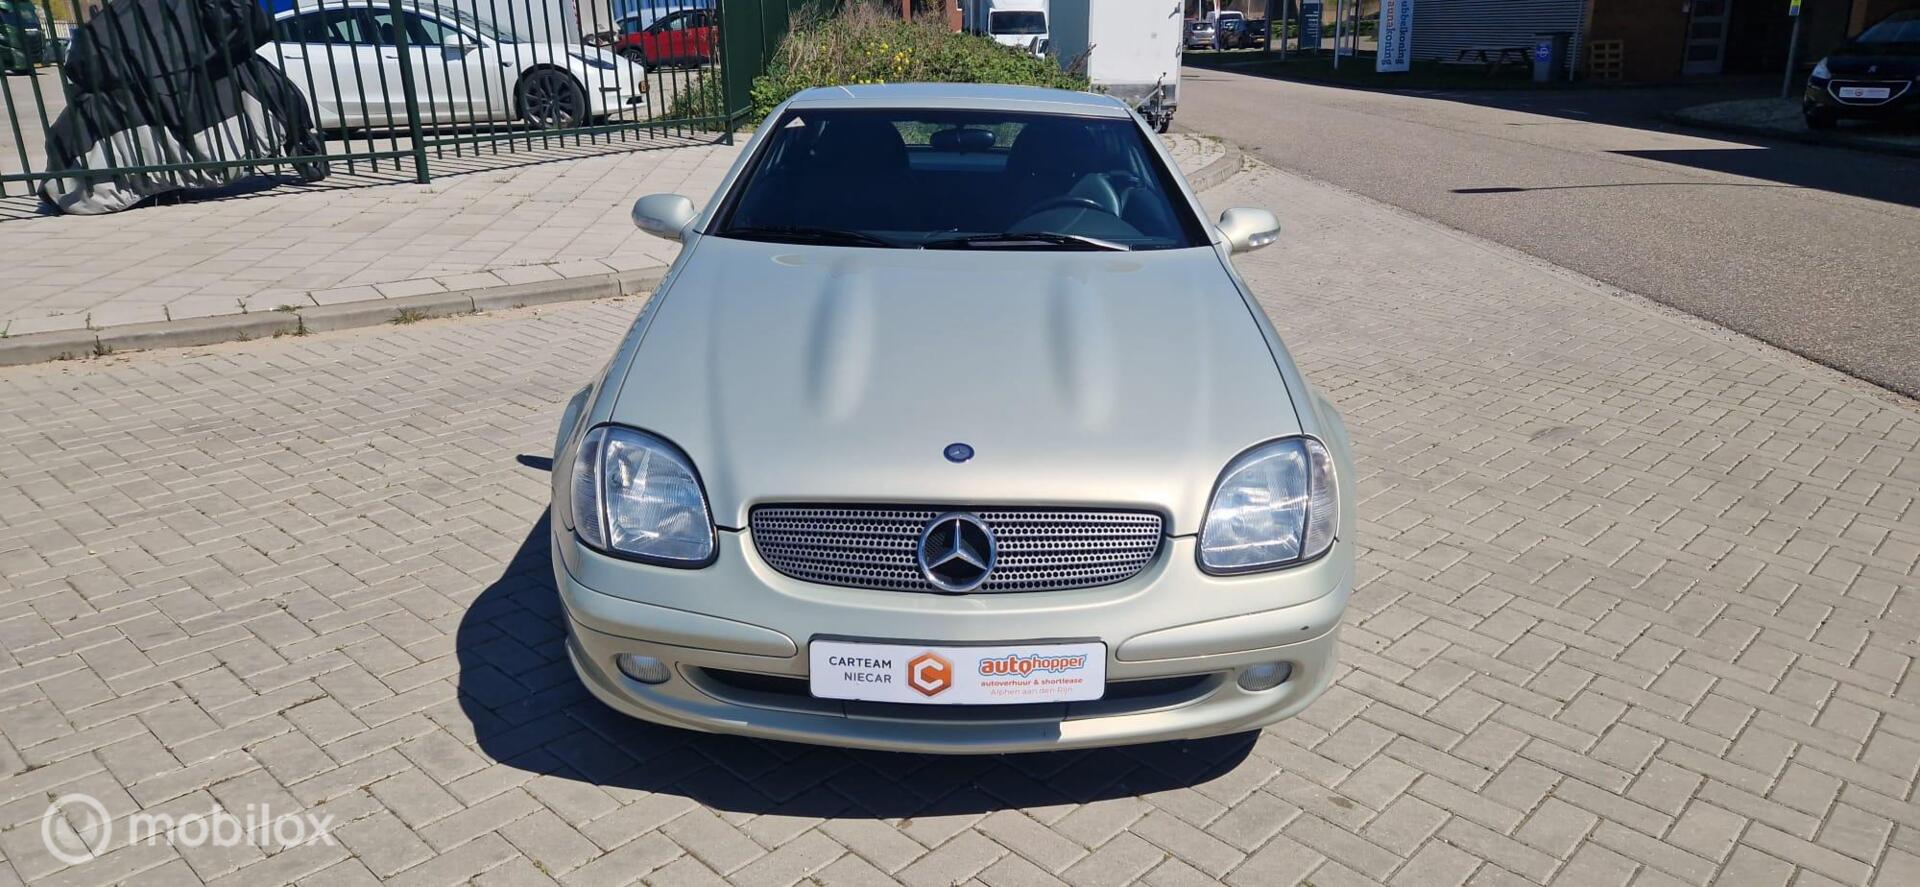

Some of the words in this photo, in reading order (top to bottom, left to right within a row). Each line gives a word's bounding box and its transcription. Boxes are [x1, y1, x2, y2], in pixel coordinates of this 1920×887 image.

[828, 655, 892, 669] CARTEAM
[980, 655, 1086, 676] autohopper
[844, 671, 892, 684] NIECAR
[981, 679, 1032, 687] autoverhuur
[1041, 677, 1083, 685] shortlease
[991, 688, 1020, 697] Alphen
